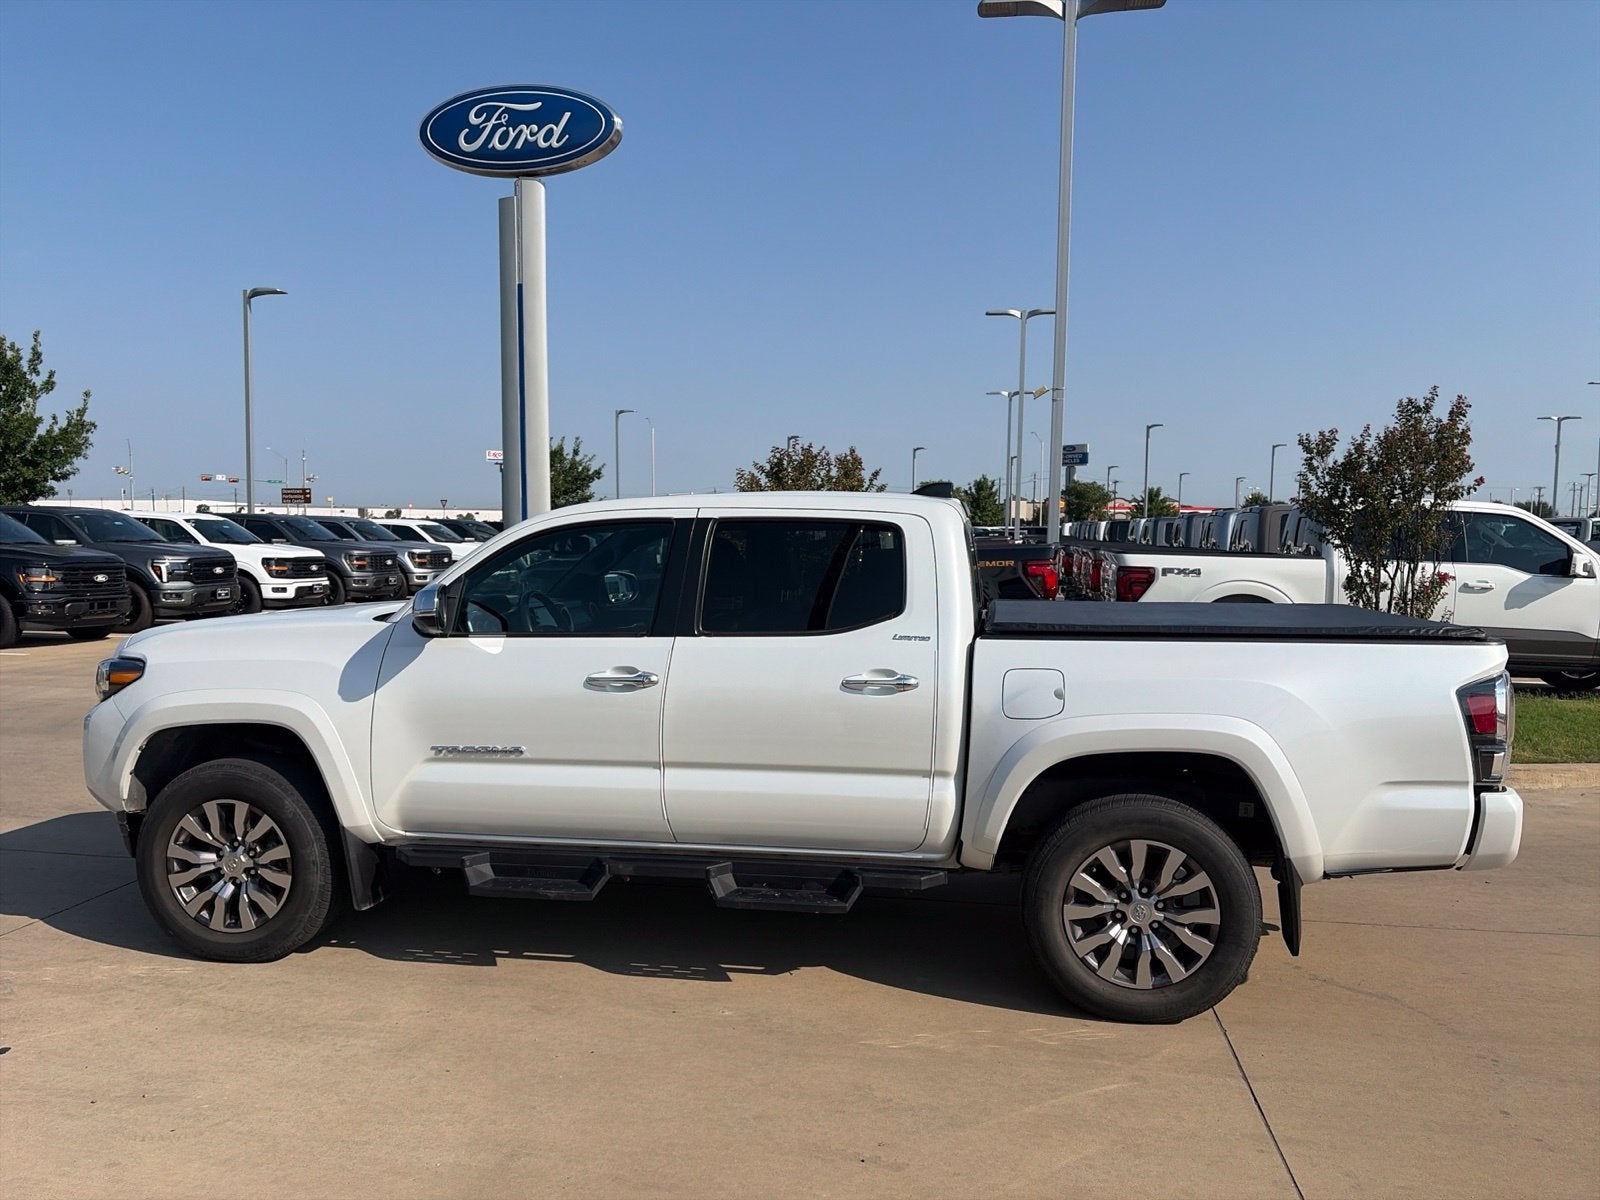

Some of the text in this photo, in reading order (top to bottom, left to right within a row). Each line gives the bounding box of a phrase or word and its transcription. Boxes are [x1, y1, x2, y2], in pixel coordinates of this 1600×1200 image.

[458, 101, 572, 152] Ford
[487, 450, 503, 458] Exxo
[978, 560, 1015, 568] EMOR
[1161, 567, 1202, 577] FX4
[430, 745, 526, 757] TACOMA
